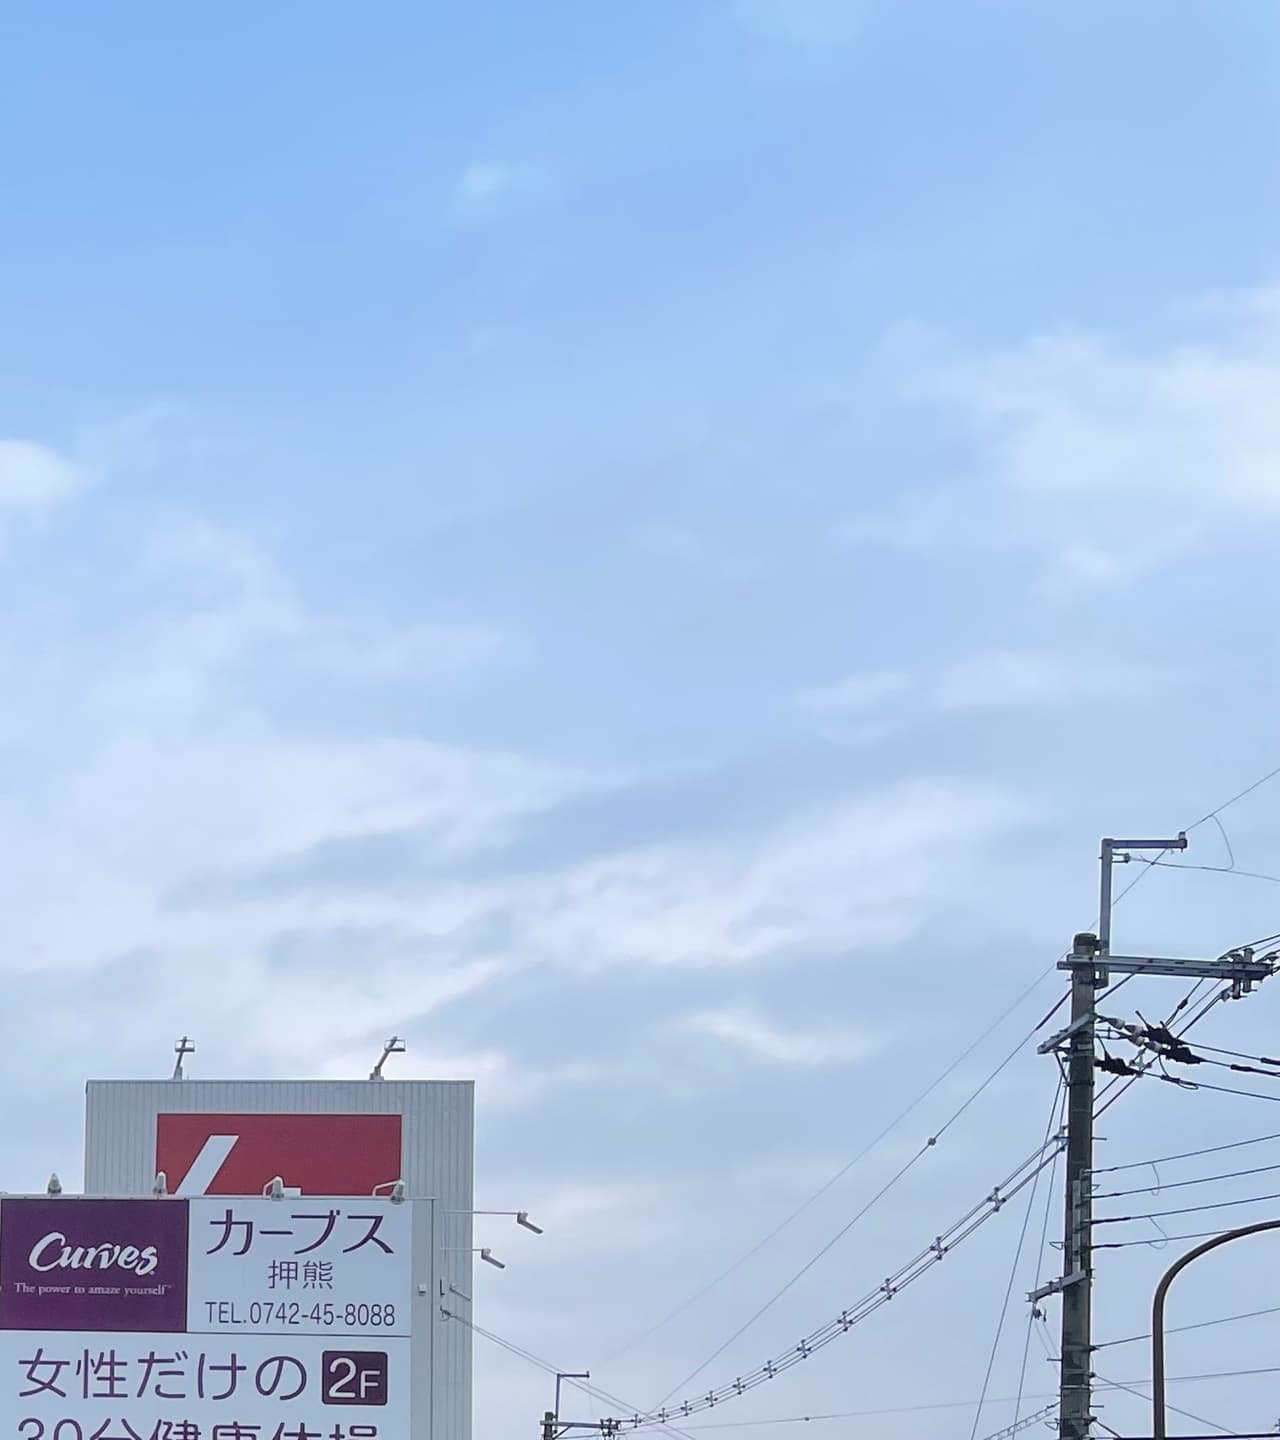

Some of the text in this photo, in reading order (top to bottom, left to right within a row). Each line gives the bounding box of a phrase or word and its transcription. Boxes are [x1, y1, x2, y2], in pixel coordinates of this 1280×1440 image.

[206, 1209, 395, 1256] カーブス
[28, 1232, 160, 1276] Curves
[14, 1282, 166, 1297] The power to amaze yourself
[267, 1260, 334, 1290] 押熊
[205, 1301, 397, 1328] TEL.0742-45-8088
[17, 1348, 382, 1401] 女性だけの 2F
